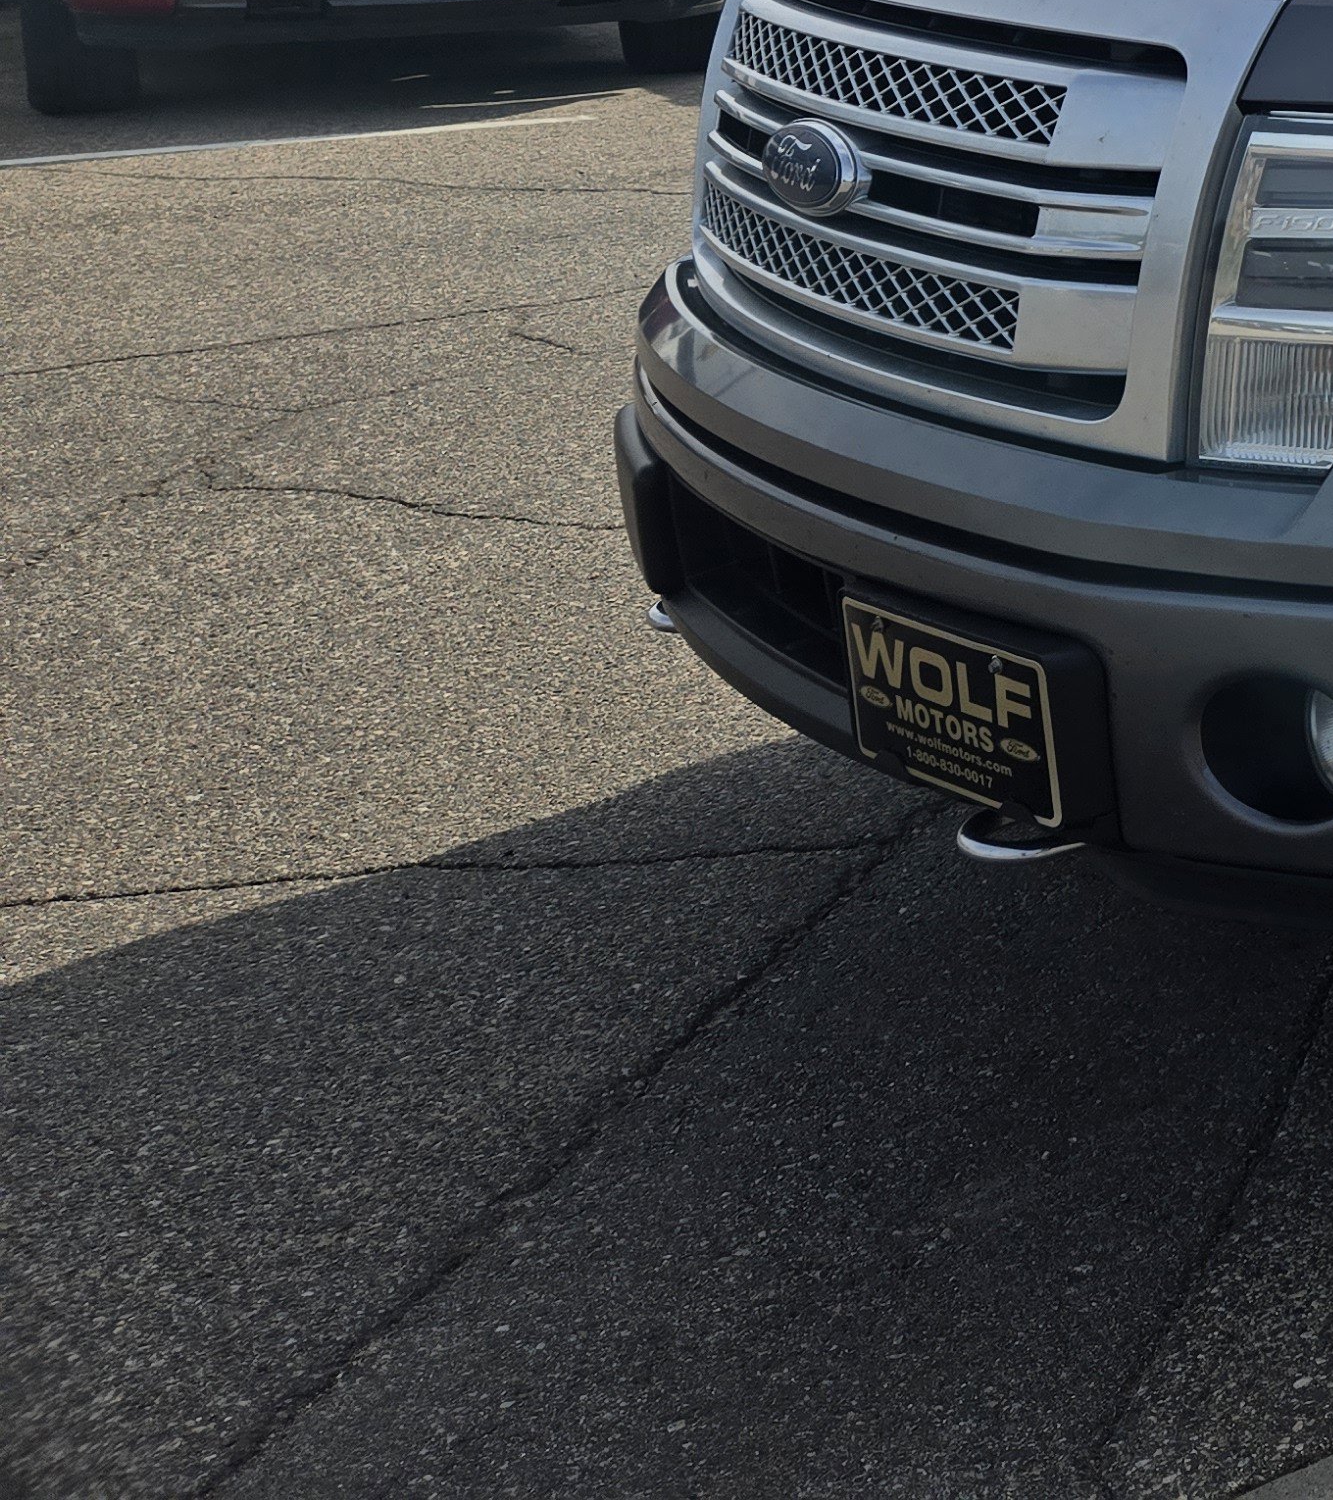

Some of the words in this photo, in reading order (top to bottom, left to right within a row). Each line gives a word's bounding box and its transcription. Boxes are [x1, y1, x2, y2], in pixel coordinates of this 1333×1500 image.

[770, 134, 821, 192] Ford
[851, 622, 1032, 729] WOLF
[863, 686, 888, 706] Ford
[885, 721, 1013, 778] www.wolfmotors.com
[895, 694, 995, 753] MOTORS
[1004, 739, 1033, 759] Ford
